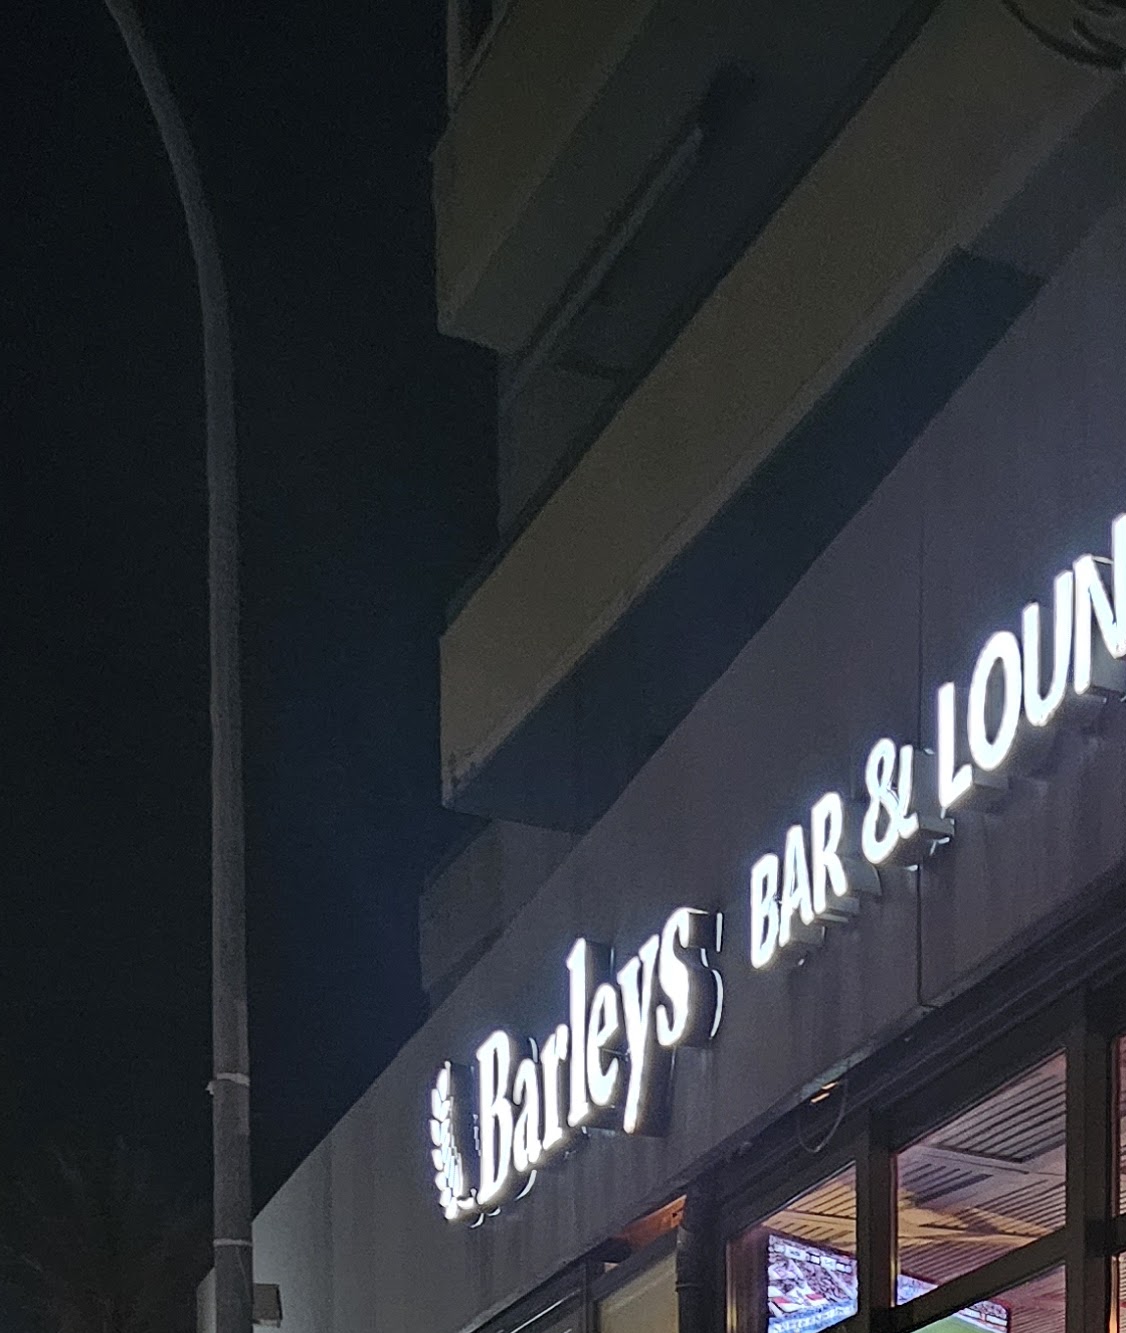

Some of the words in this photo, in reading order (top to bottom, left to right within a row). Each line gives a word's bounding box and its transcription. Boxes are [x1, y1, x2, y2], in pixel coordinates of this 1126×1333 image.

[474, 906, 694, 1208] Barleys
[750, 793, 851, 968] BAR
[862, 737, 917, 865] &
